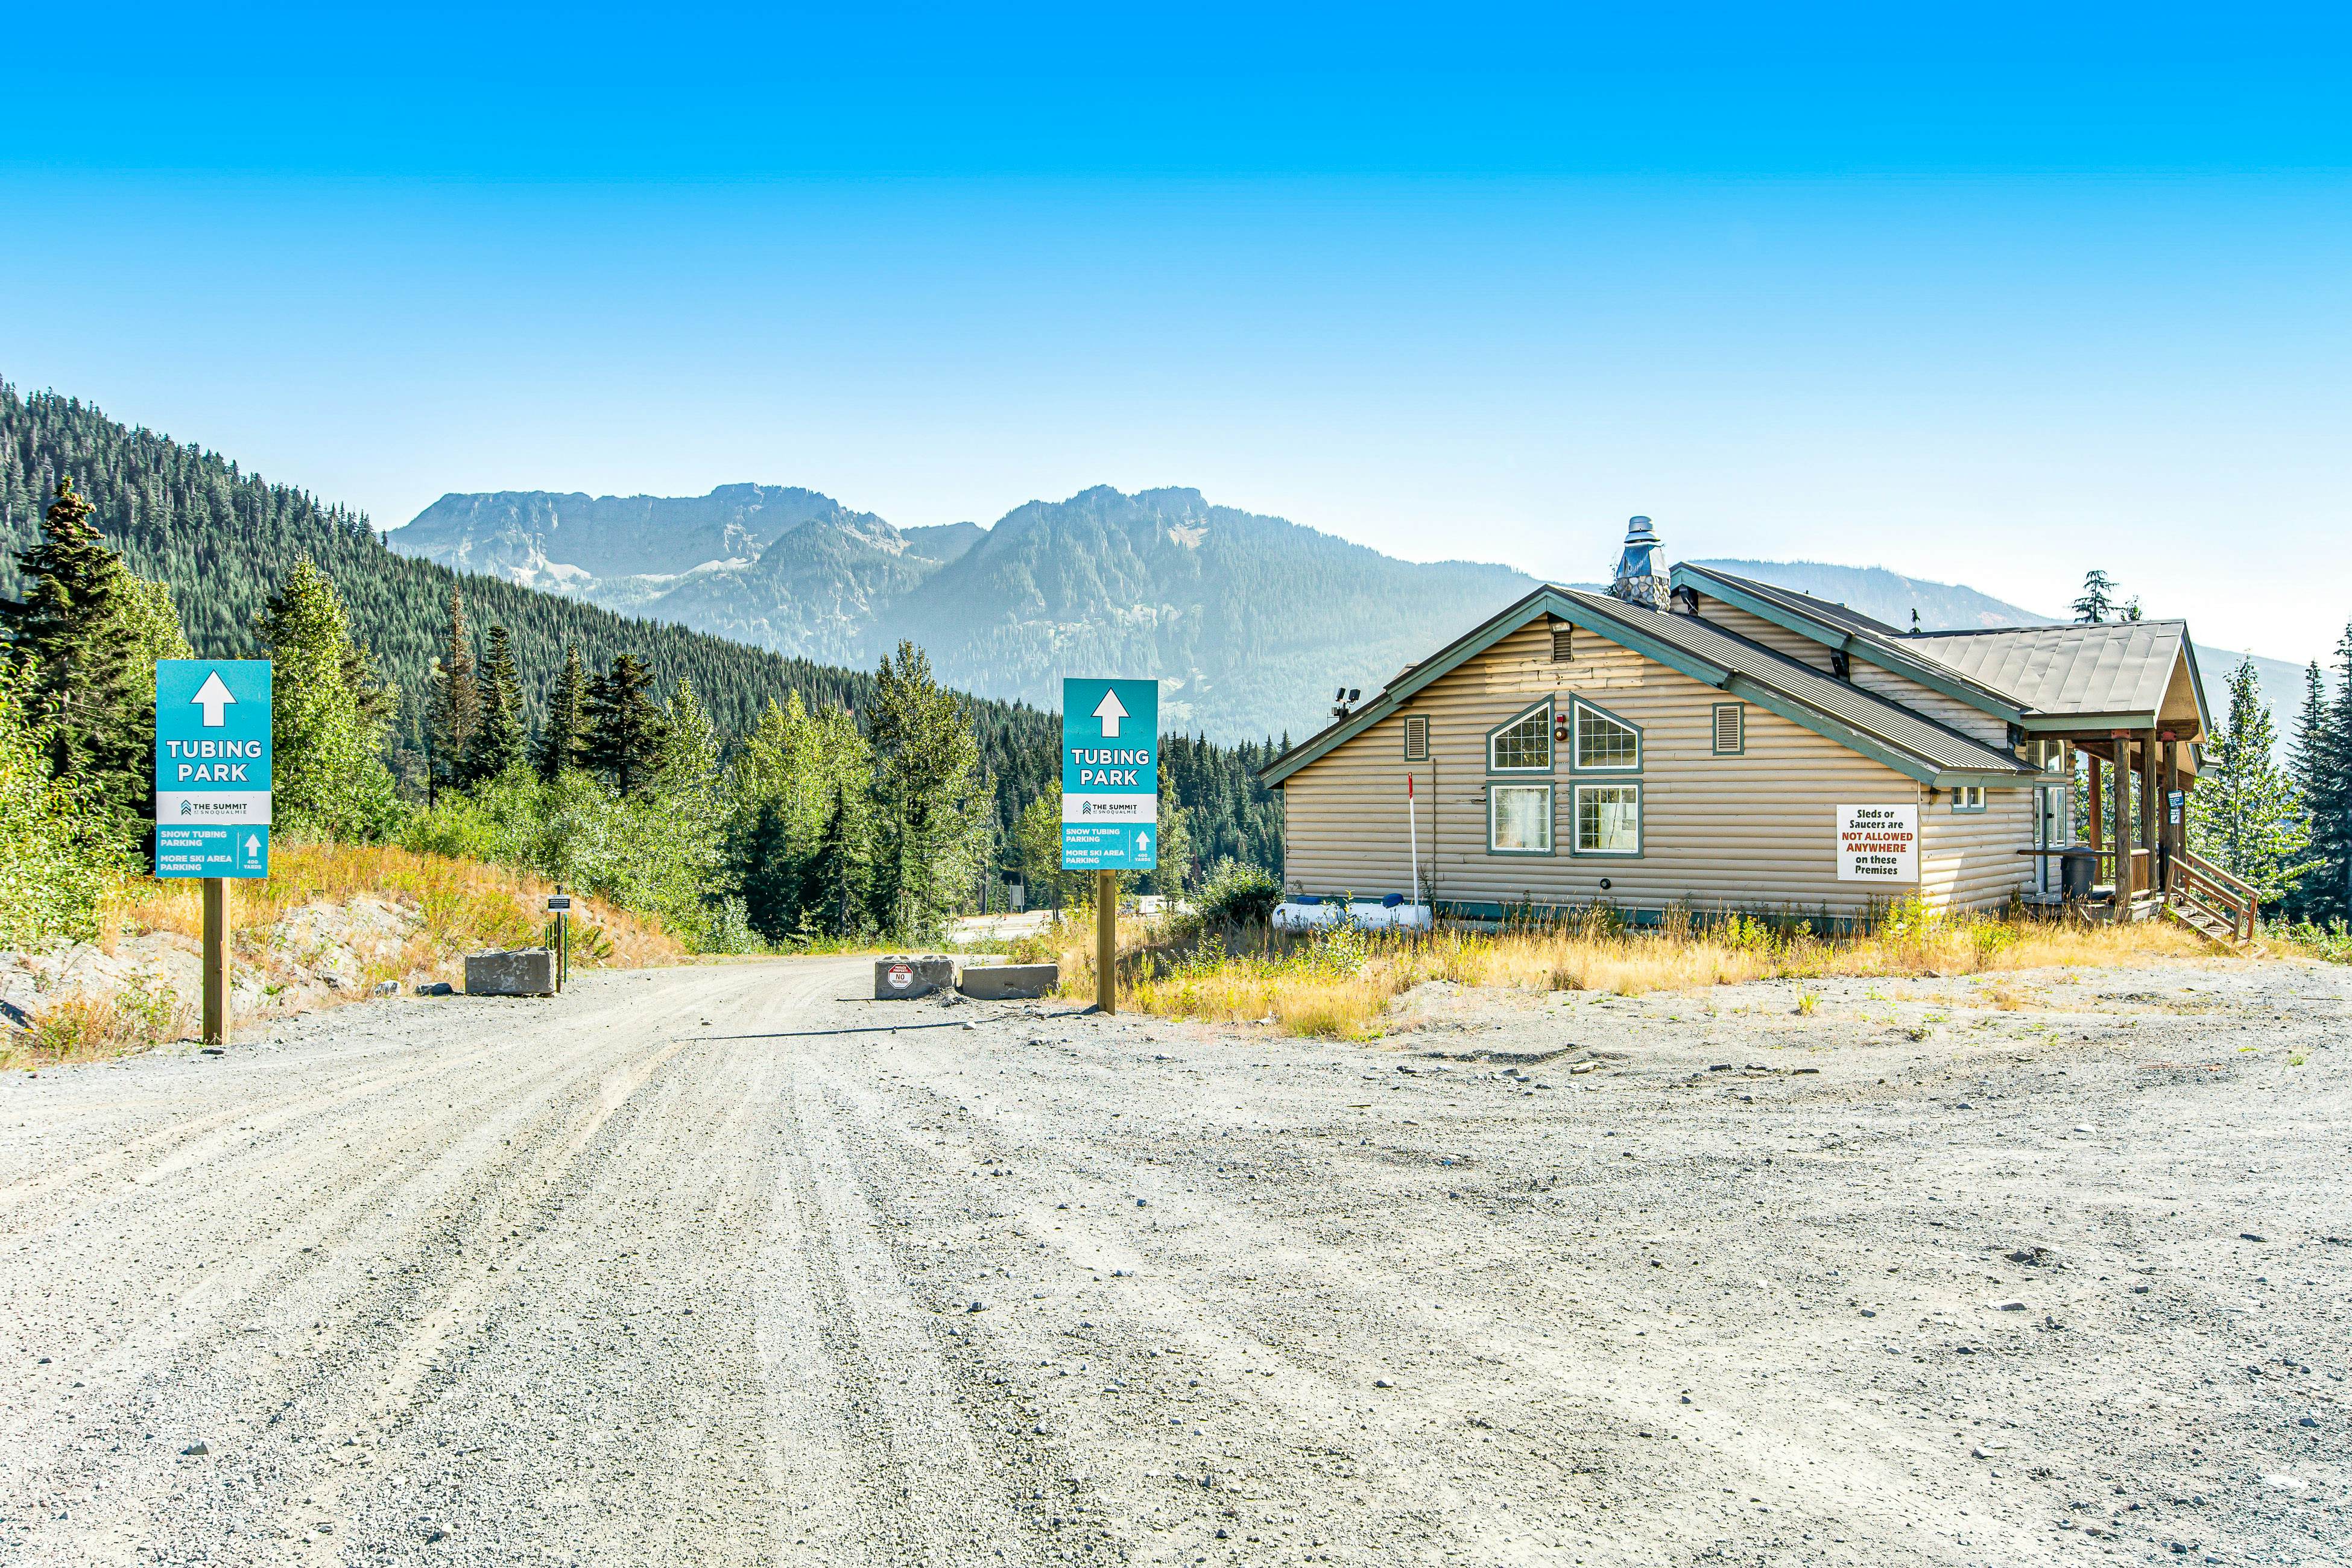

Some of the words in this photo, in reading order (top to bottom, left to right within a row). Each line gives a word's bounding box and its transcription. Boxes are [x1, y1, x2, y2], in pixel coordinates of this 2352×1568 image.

[166, 740, 262, 758] TUBING
[1071, 748, 1149, 765] TUBING
[178, 763, 250, 782] PARK
[1080, 769, 1139, 786] PARK
[1857, 809, 1882, 818] Sleds
[1849, 820, 1885, 829] Saucers
[1842, 832, 1862, 841] NOT
[1864, 832, 1913, 841] ALLOWED
[1846, 843, 1906, 852] ANYWHERE
[1870, 855, 1897, 864] these
[1855, 865, 1898, 874] Premises
